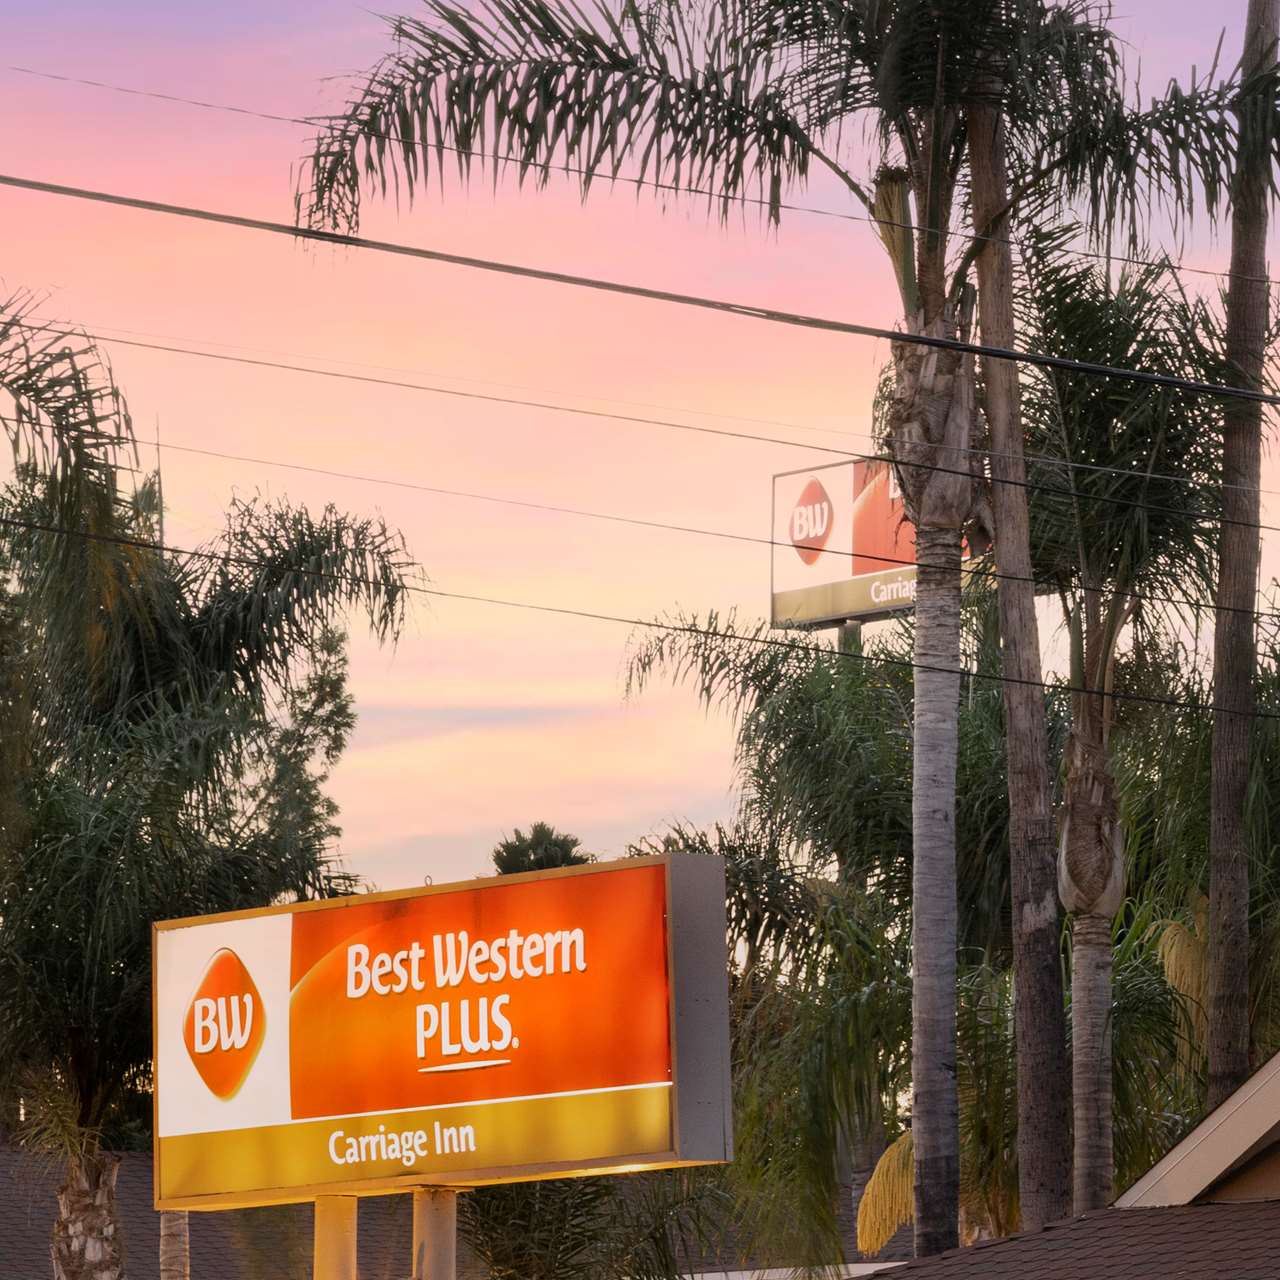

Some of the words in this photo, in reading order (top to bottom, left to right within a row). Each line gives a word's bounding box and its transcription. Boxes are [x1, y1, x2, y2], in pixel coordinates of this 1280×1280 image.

[793, 502, 828, 541] BW
[871, 576, 917, 602] Carriag
[347, 944, 424, 998] Best
[433, 927, 586, 988] Western
[194, 993, 253, 1053] BW
[328, 1125, 428, 1166] Carriage
[435, 1121, 476, 1154] Inn
